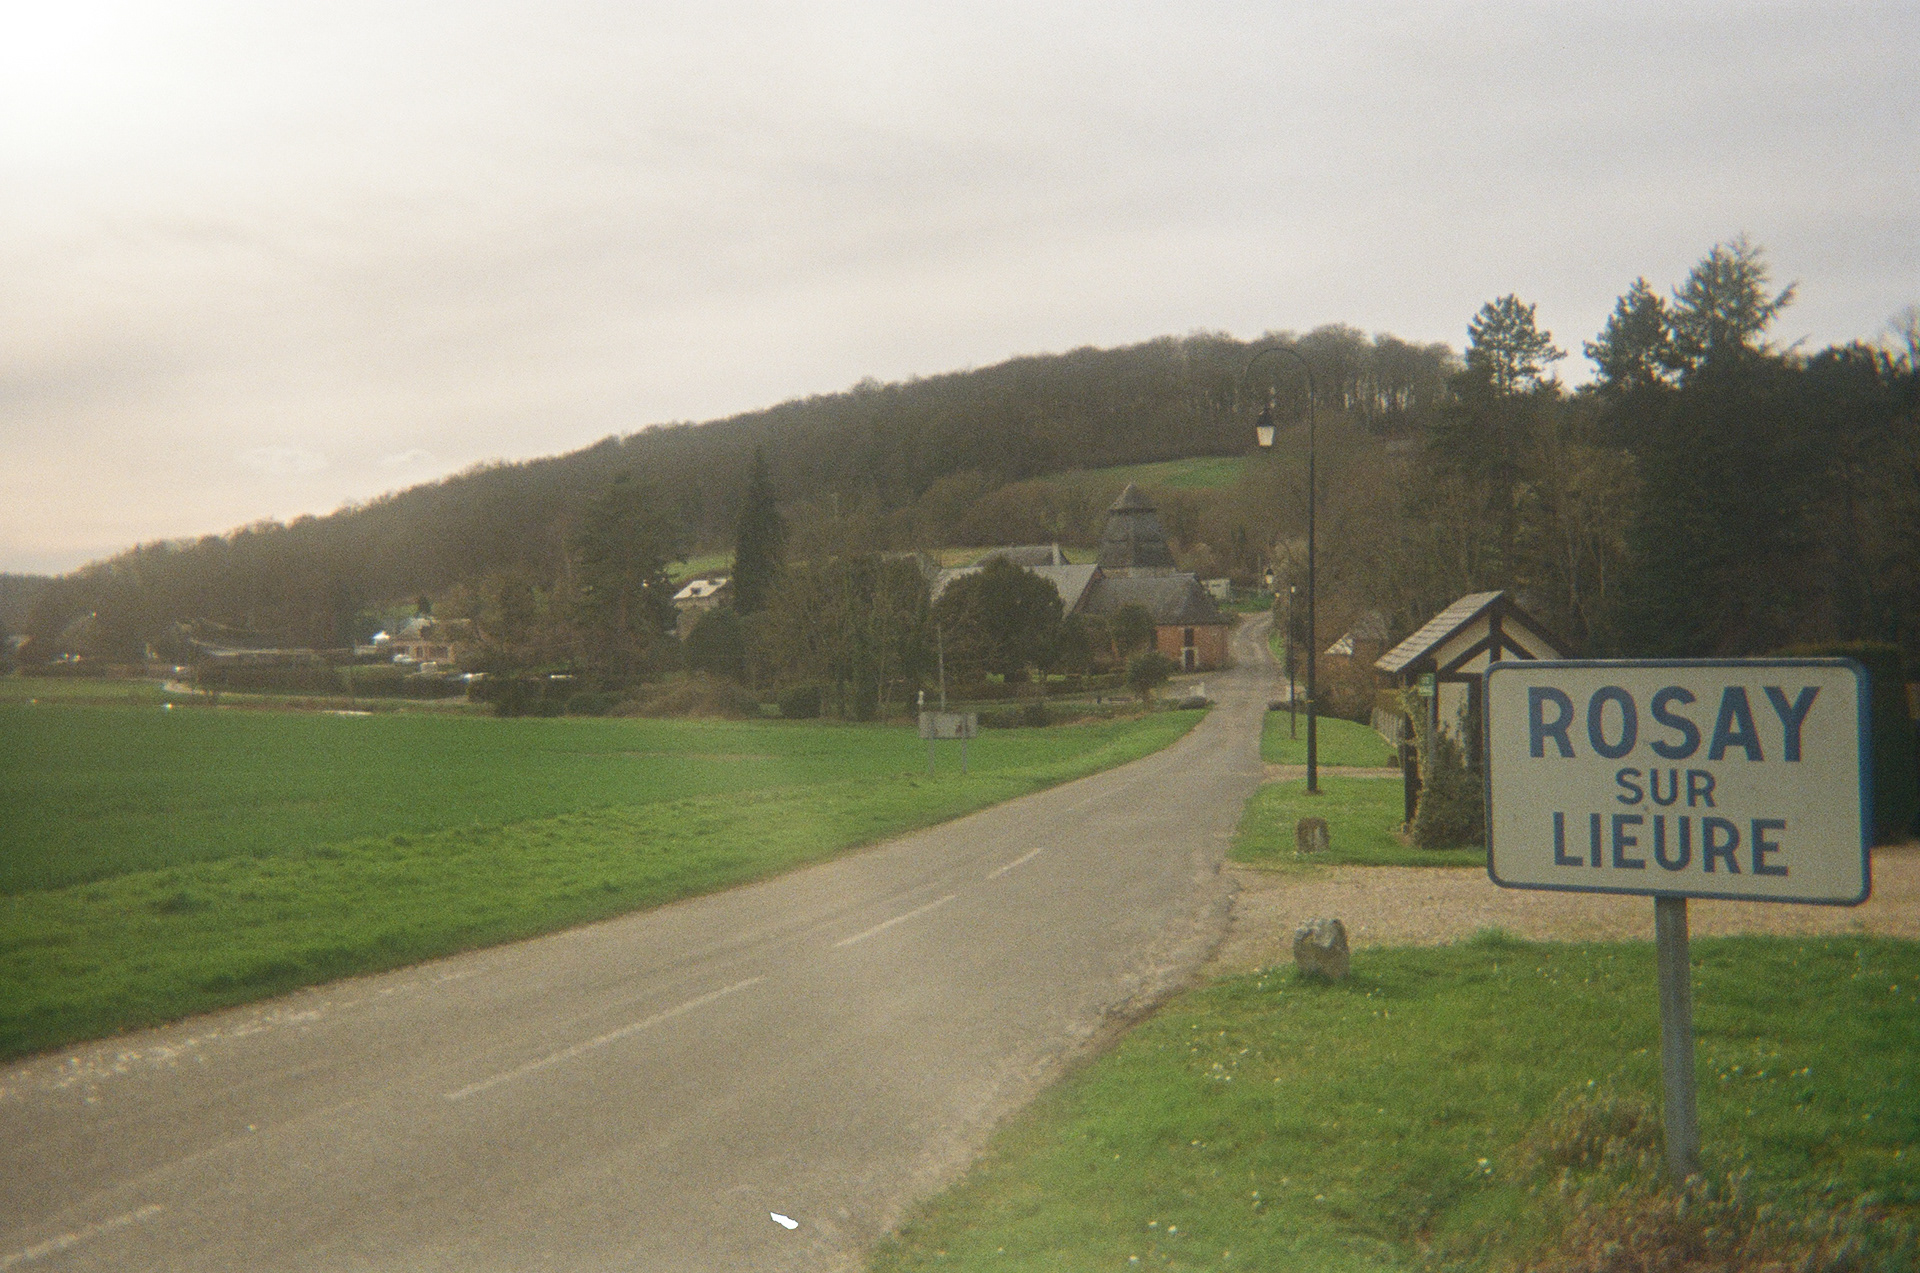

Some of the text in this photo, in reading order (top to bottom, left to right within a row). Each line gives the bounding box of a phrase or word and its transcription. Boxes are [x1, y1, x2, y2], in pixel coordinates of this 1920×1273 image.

[1528, 685, 1821, 762] ROSAY
[1615, 767, 1716, 807] SUR
[1553, 811, 1789, 876] LIEURE
